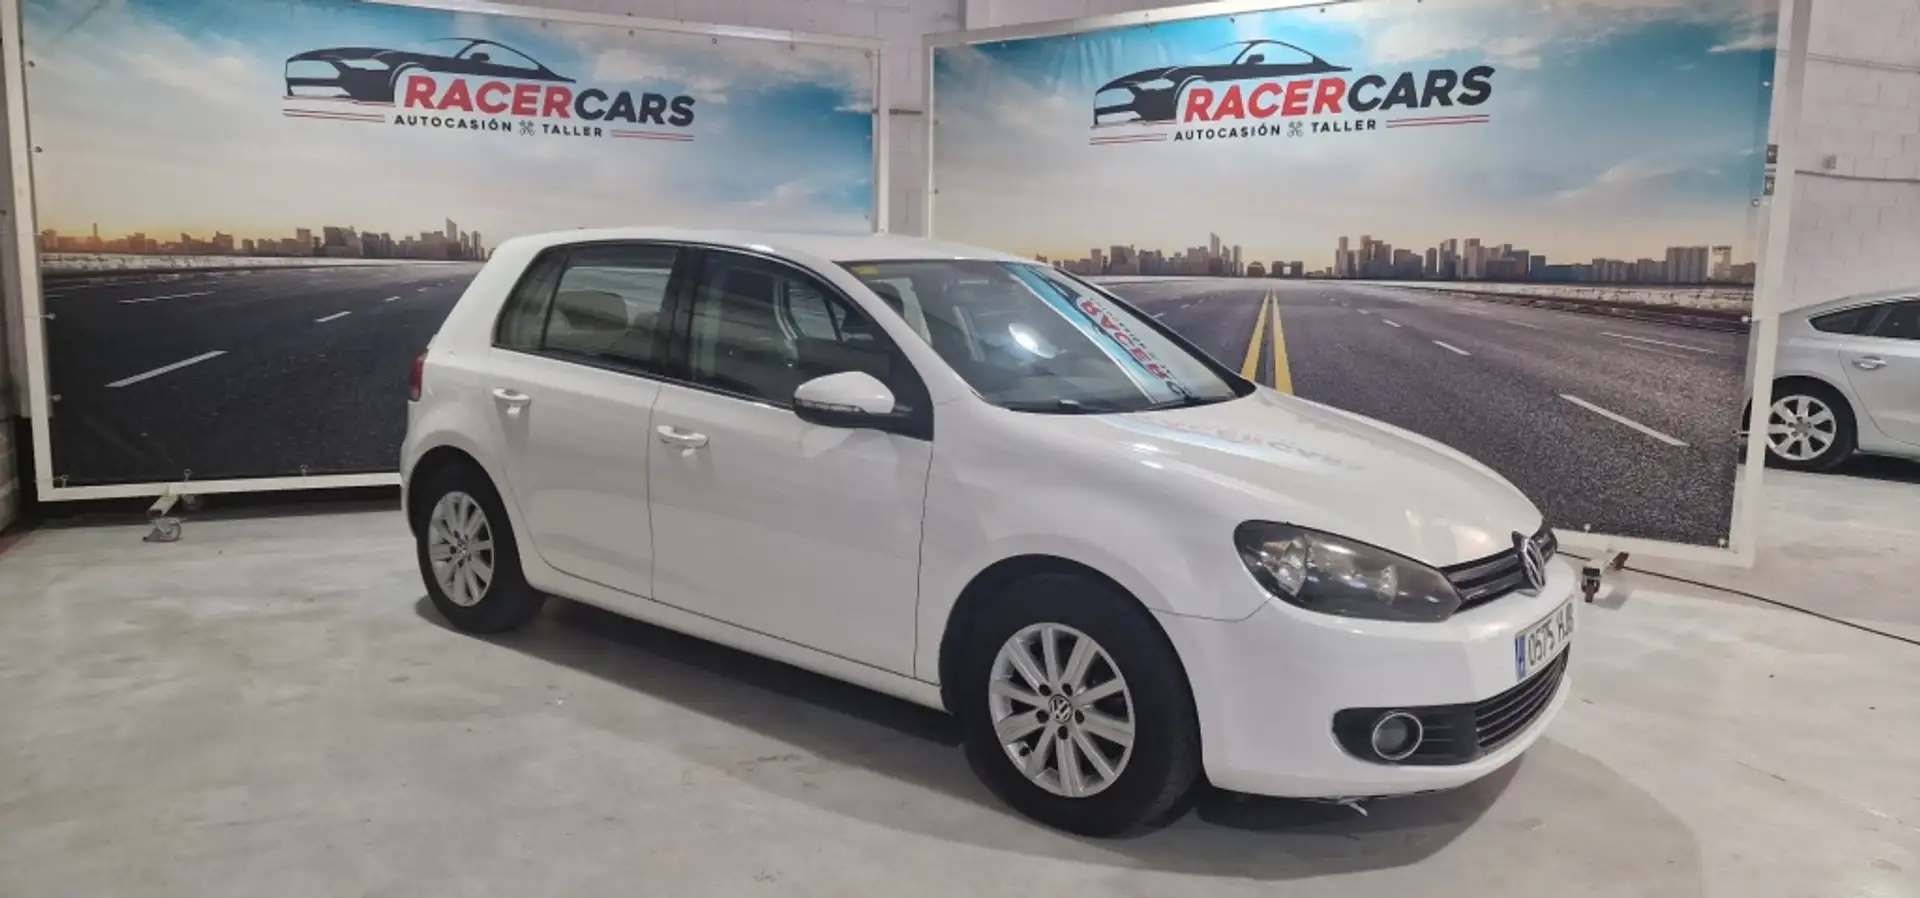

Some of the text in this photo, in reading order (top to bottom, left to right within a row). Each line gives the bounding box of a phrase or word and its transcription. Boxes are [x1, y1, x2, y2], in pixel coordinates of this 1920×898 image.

[394, 114, 603, 138] AUTOCASIÓN TALLER
[1174, 119, 1377, 141] AUTOCASIÓN TALLER
